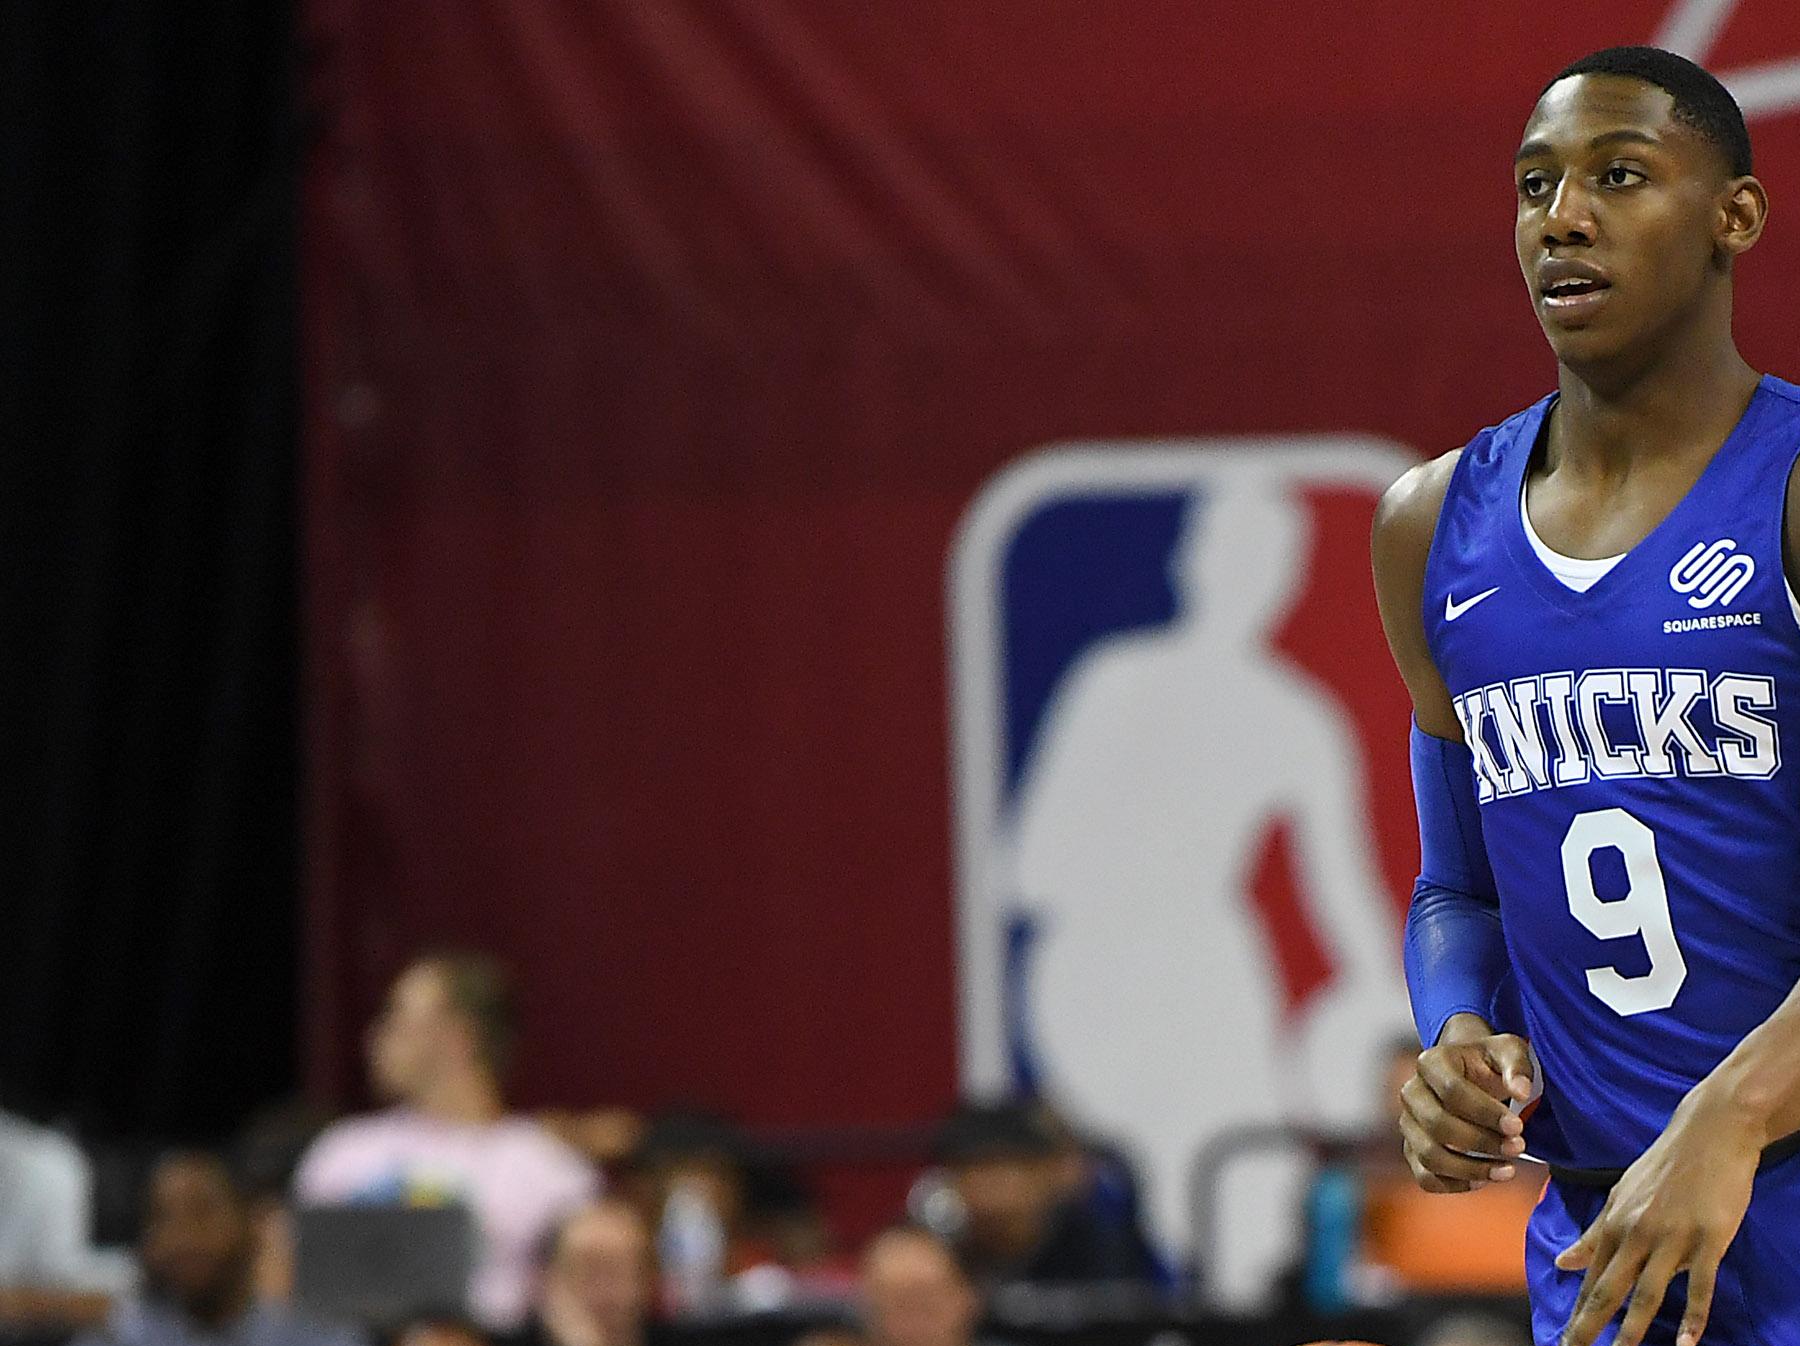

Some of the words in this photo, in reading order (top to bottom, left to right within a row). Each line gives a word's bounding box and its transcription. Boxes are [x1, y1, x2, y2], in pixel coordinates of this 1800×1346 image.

[1663, 612, 1761, 634] SQUARESPACE
[1453, 668, 1783, 804] KNICKS
[1561, 808, 1687, 1017] 9
